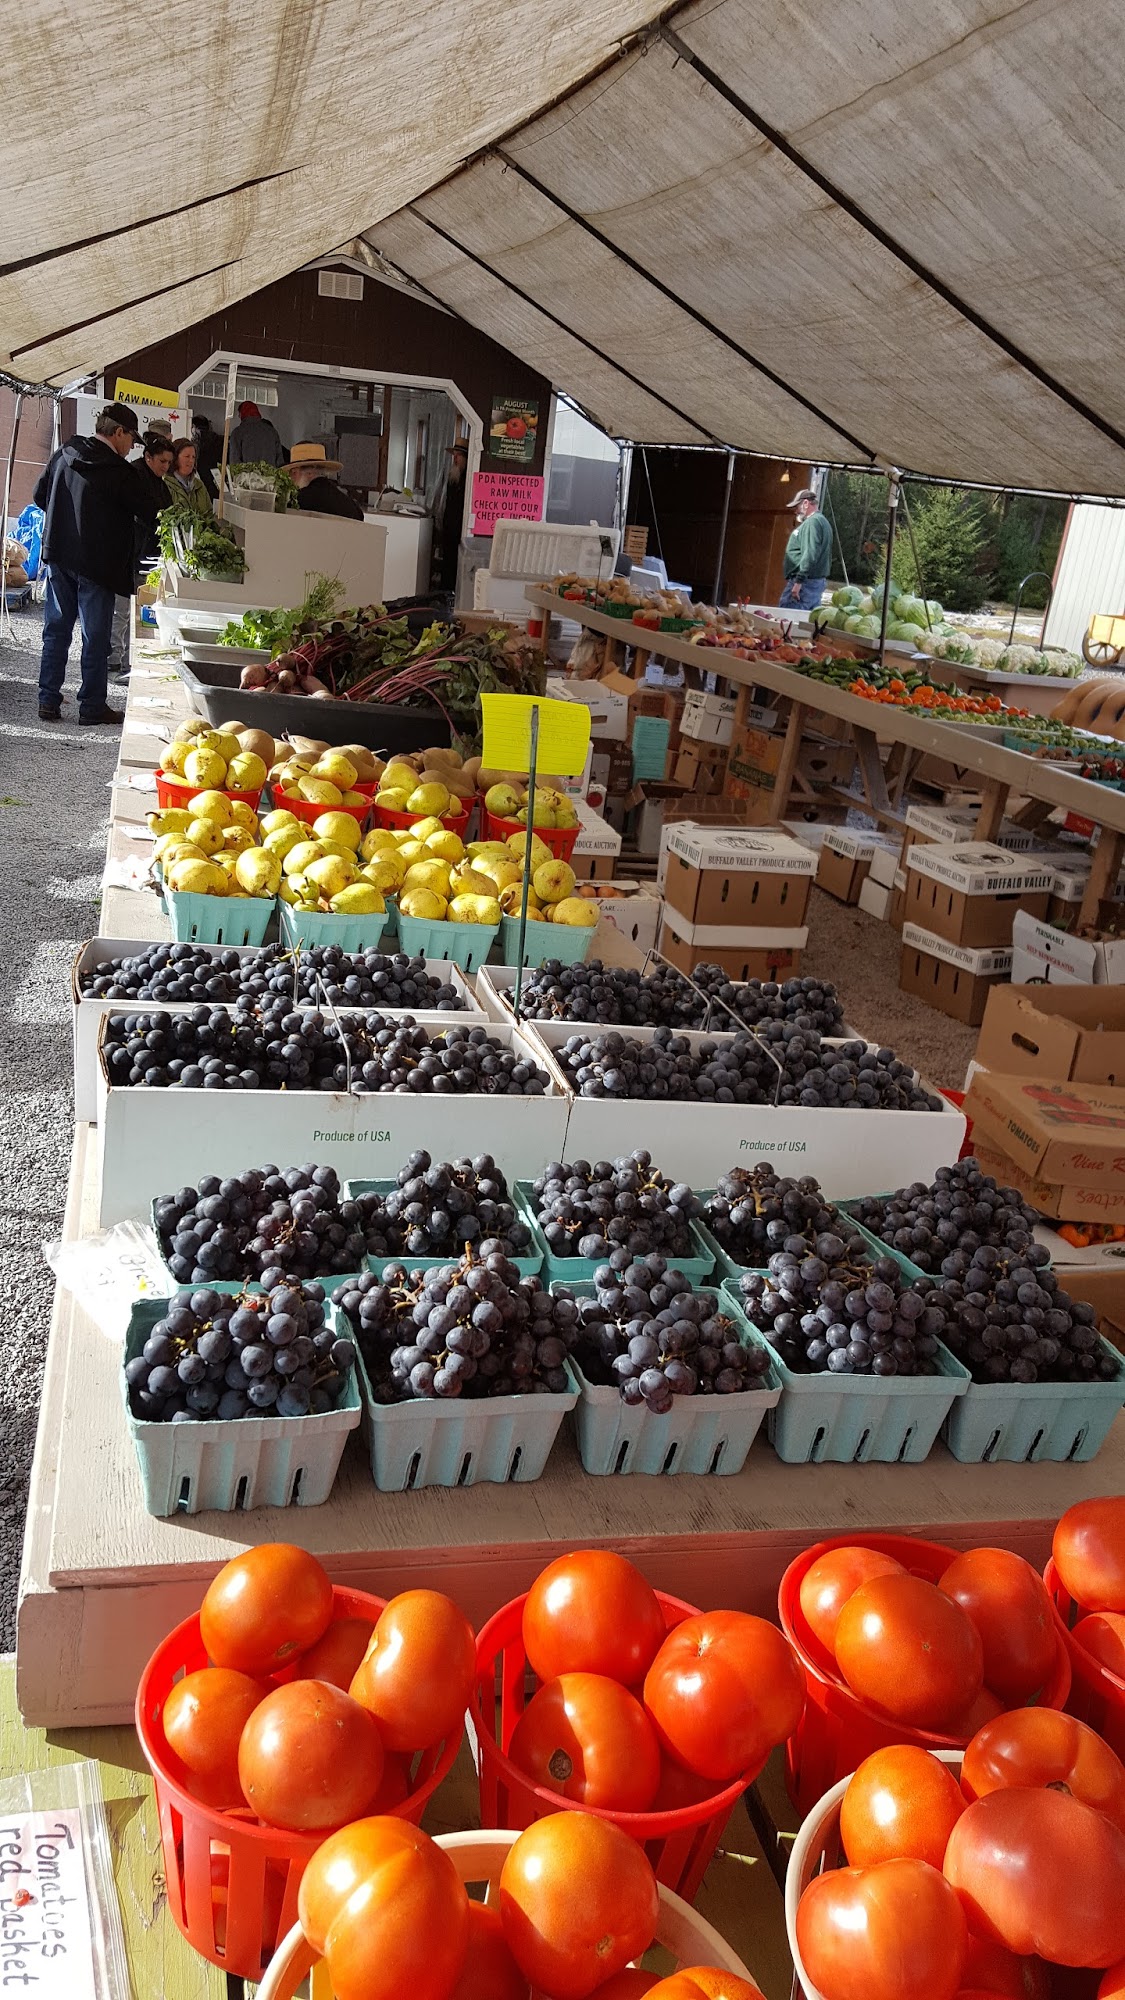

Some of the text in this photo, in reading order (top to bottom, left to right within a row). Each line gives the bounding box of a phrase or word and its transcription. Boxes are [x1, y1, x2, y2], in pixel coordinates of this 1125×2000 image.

[118, 391, 140, 405] RAW
[503, 400, 528, 409] AUGUST
[478, 474, 540, 488] PDA INSPECTED
[490, 488, 532, 500] RAW MILK
[474, 500, 539, 513] CHECK OUT OUR
[476, 510, 505, 521] CHEESE
[574, 841, 617, 850] ODUCE AUCTION
[674, 836, 689, 855] BUFFALO
[1004, 838, 1031, 849] VALLEY
[708, 855, 812, 869] BUFFALO VALLEY PRODUCE AUCTION
[910, 852, 925, 865] BUFFALO
[924, 857, 937, 872] VALLEY
[936, 864, 952, 878] PRODUCE
[951, 871, 966, 884] AUCTION
[987, 875, 1052, 890] BUFFALO VALLEY
[1035, 926, 1065, 946] PERISHABLE
[905, 930, 973, 965] BUFFALO VALLEY PRODUCE AUCTION
[313, 1130, 391, 1142] Produce of USA
[1006, 1119, 1041, 1154] TOMATOES
[739, 1139, 806, 1152] Produce of USA
[1072, 1153, 1104, 1171] Vine
[34, 1823, 78, 1958] Tomatoes
